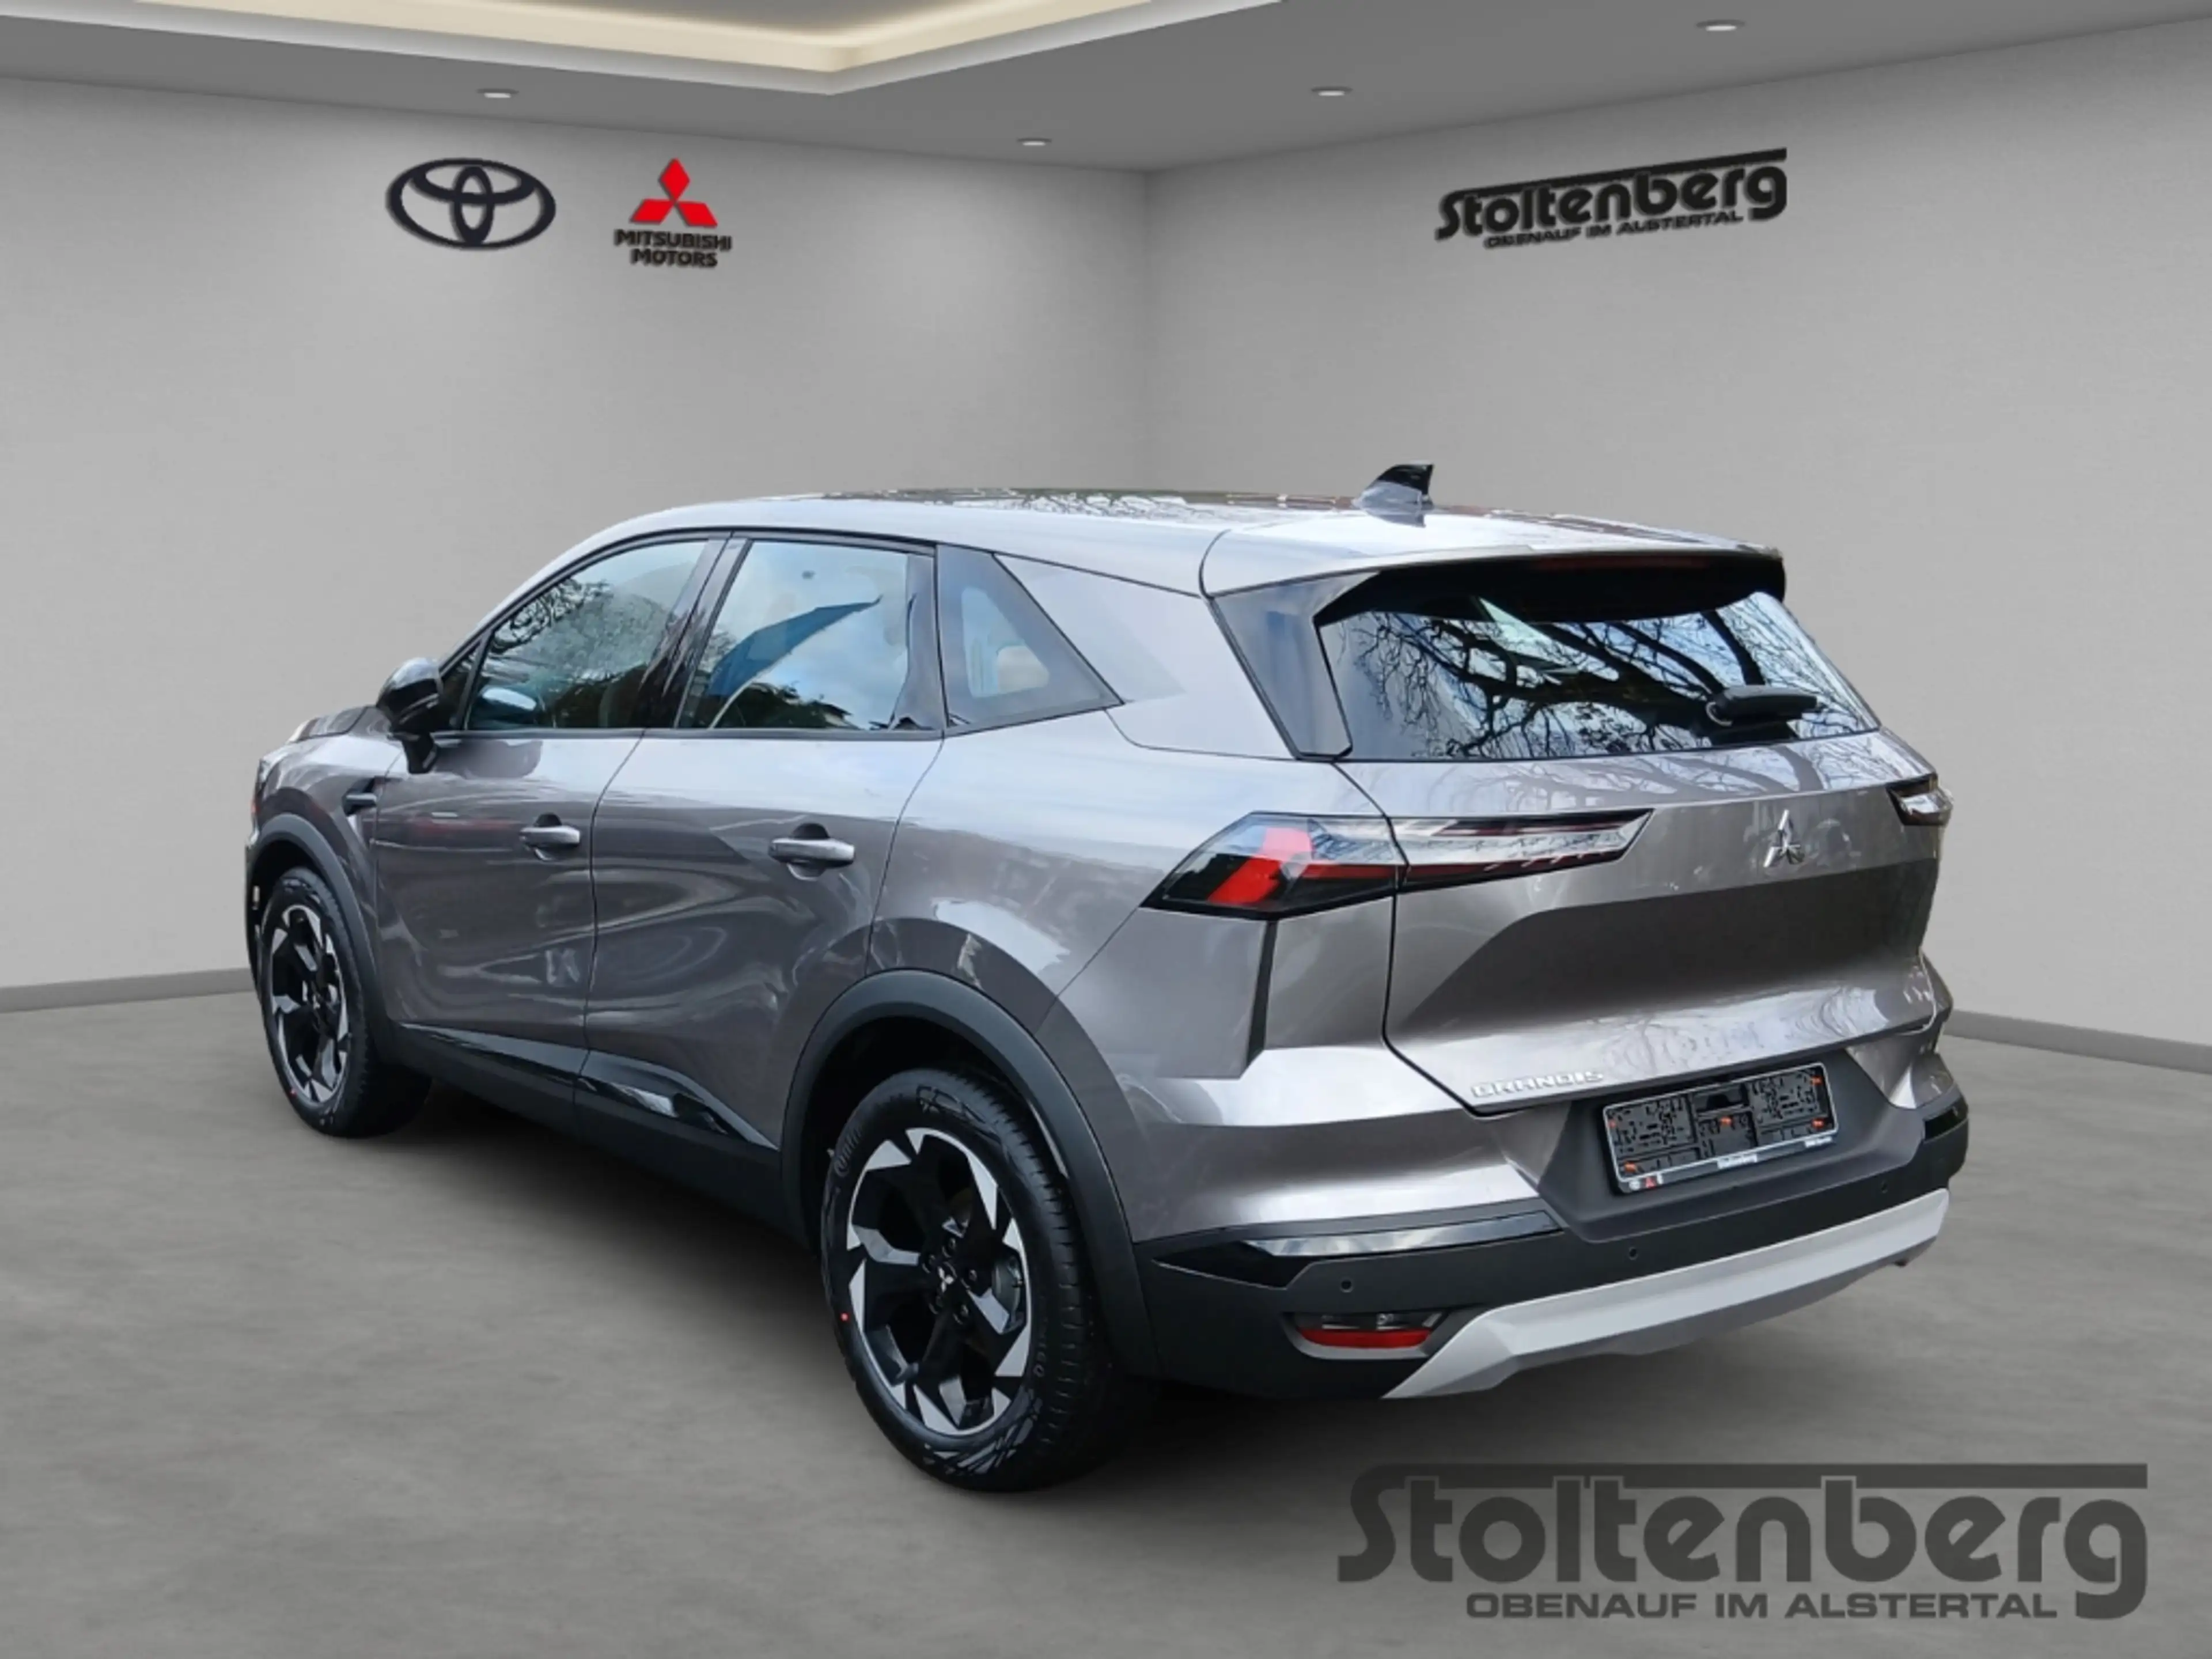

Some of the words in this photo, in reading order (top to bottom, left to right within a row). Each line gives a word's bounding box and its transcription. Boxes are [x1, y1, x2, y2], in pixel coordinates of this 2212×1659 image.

[1435, 148, 1787, 241] Stoltenberg
[613, 229, 733, 252] MITSUBISHI
[1585, 224, 1612, 238] IM
[630, 247, 718, 268] MOTORS
